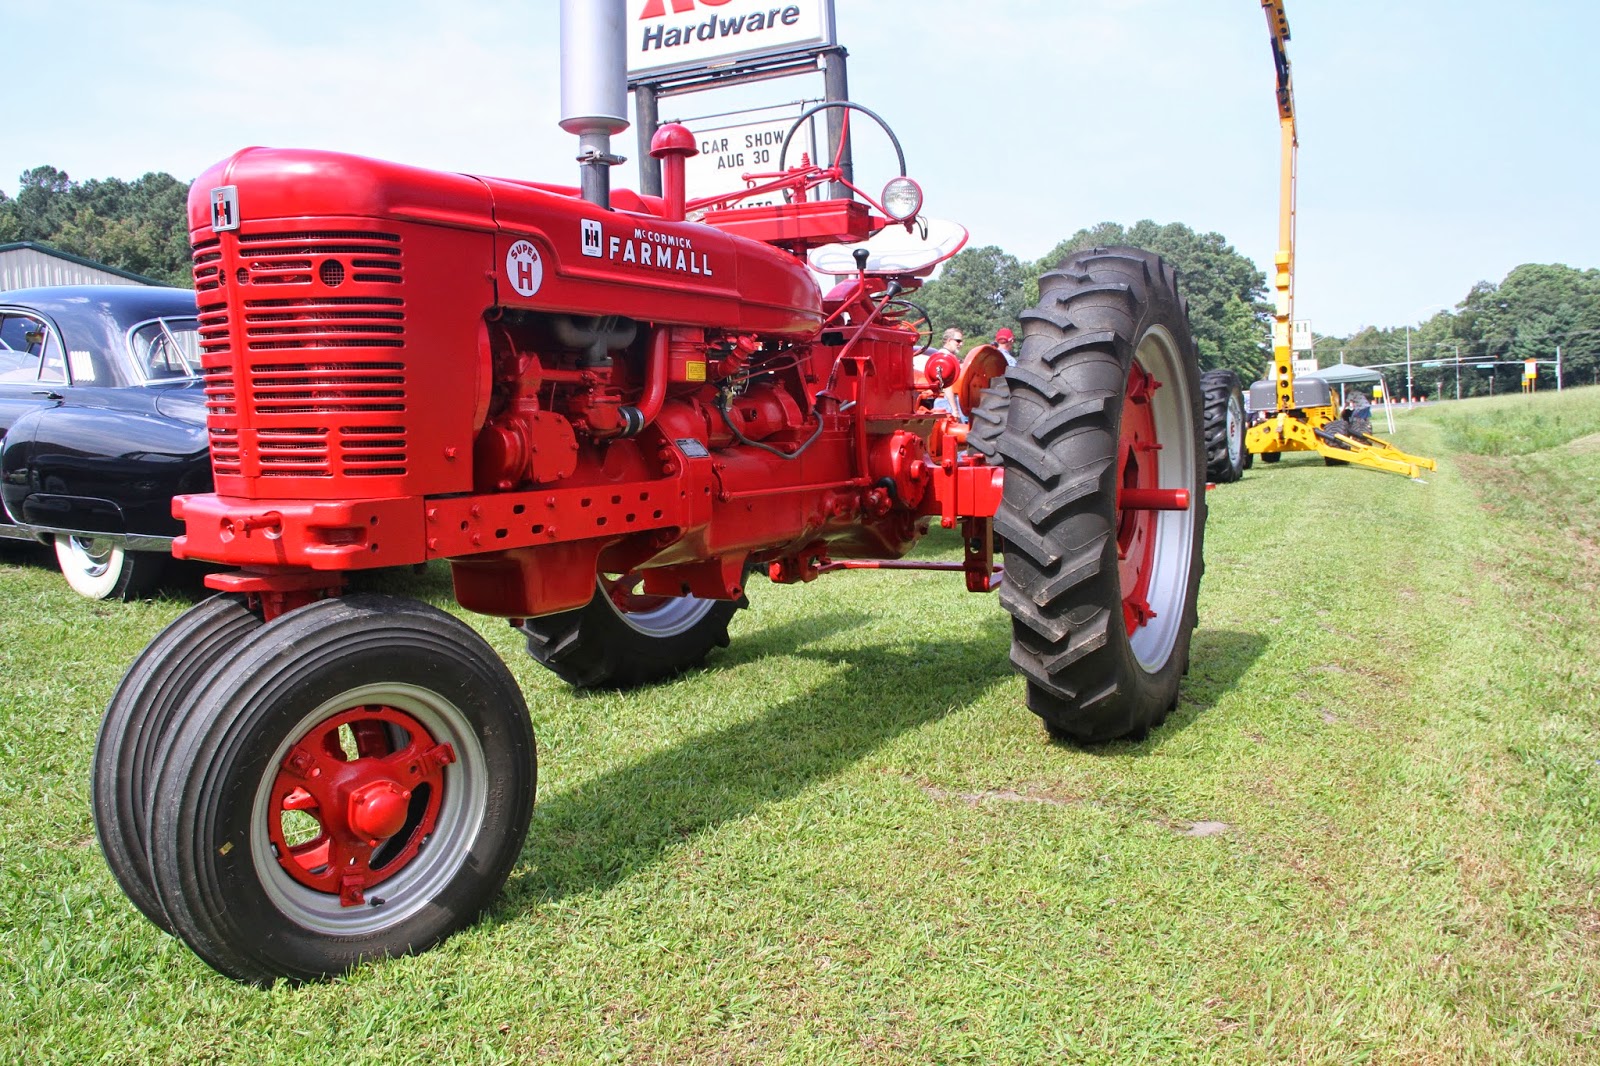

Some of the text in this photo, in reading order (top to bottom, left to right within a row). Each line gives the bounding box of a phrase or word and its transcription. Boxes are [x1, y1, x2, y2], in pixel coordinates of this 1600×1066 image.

[642, 5, 800, 51] Hardware
[702, 130, 785, 155] CAR SHOW
[717, 150, 770, 170] AUG 30
[510, 243, 538, 264] SUPER
[609, 236, 713, 276] FARMALL
[517, 261, 533, 291] H
